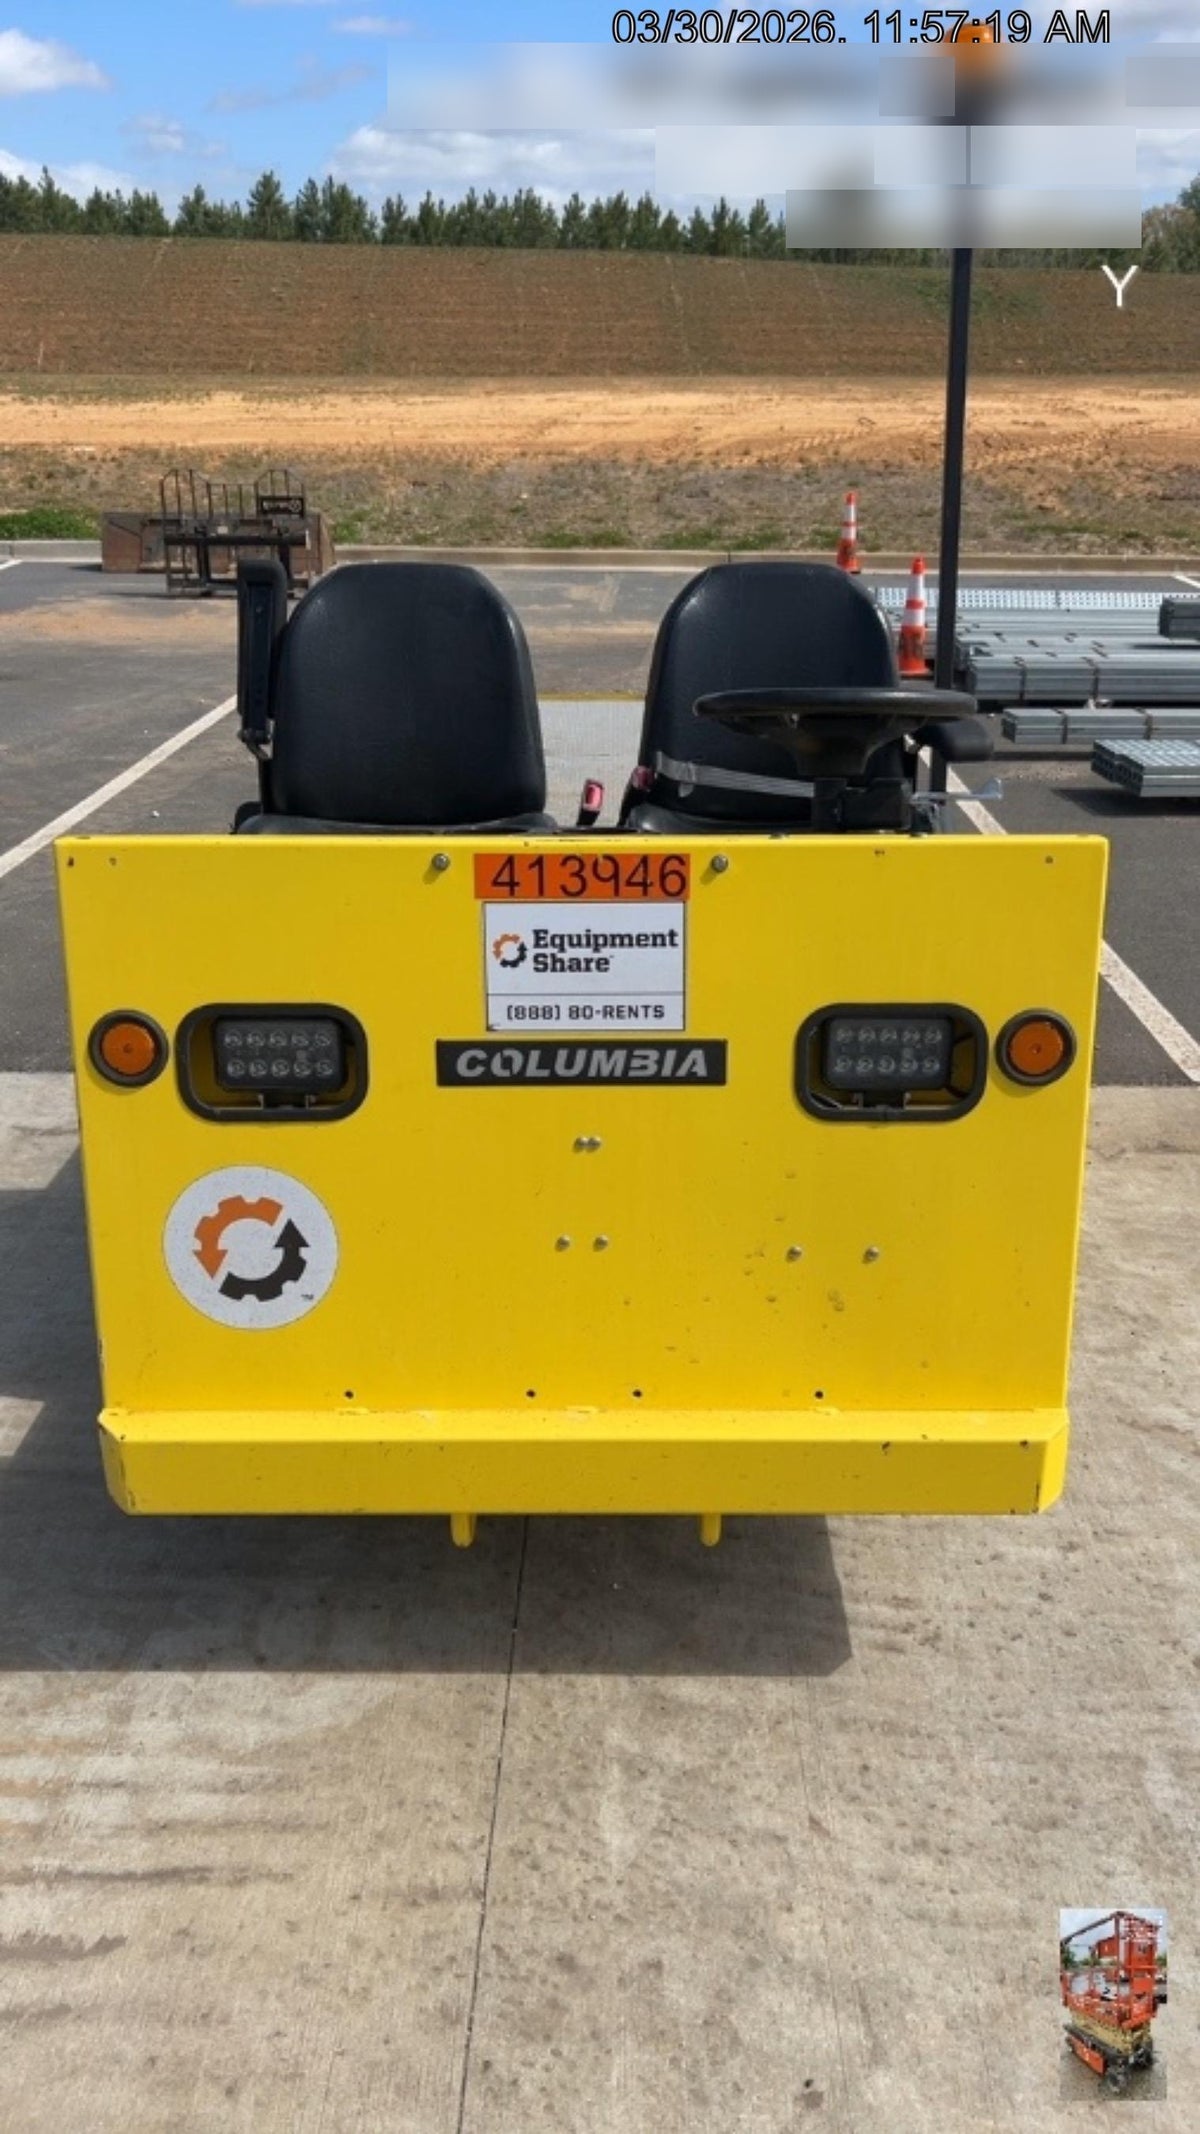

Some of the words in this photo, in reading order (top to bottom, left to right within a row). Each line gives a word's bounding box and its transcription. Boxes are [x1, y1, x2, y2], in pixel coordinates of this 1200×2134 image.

[491, 854, 687, 897] 413946
[532, 929, 679, 953] Equipment
[568, 1005, 665, 1020] 80-RENTS
[455, 1048, 709, 1077] COLUMBIA
